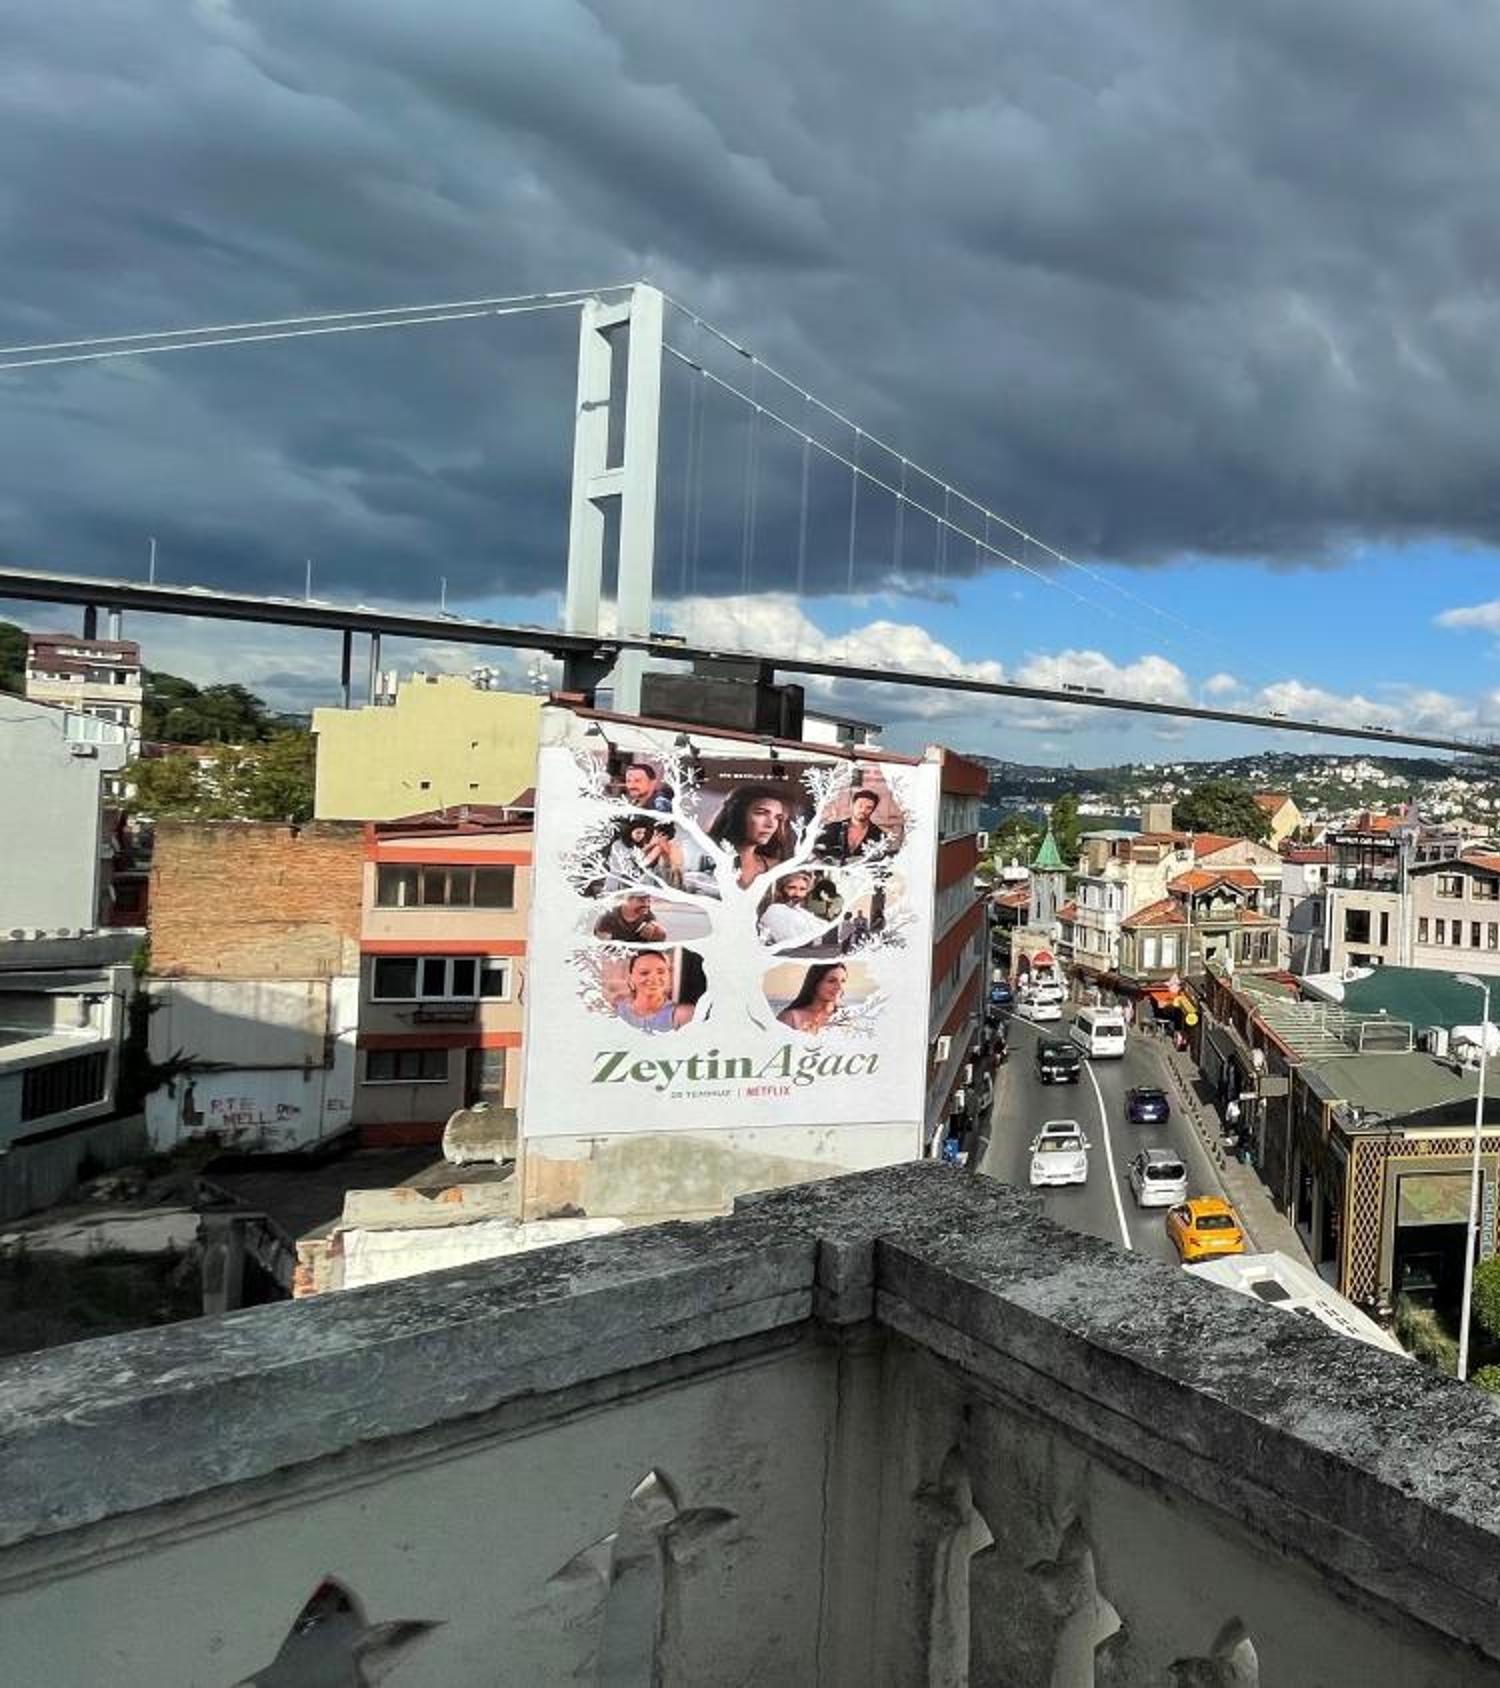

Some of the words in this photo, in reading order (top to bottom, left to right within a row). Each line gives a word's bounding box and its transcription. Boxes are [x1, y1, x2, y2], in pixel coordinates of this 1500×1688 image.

[591, 1048, 758, 1092] Zeytin
[753, 1043, 879, 1087] Ağacı
[746, 1085, 790, 1097] NETFLIX
